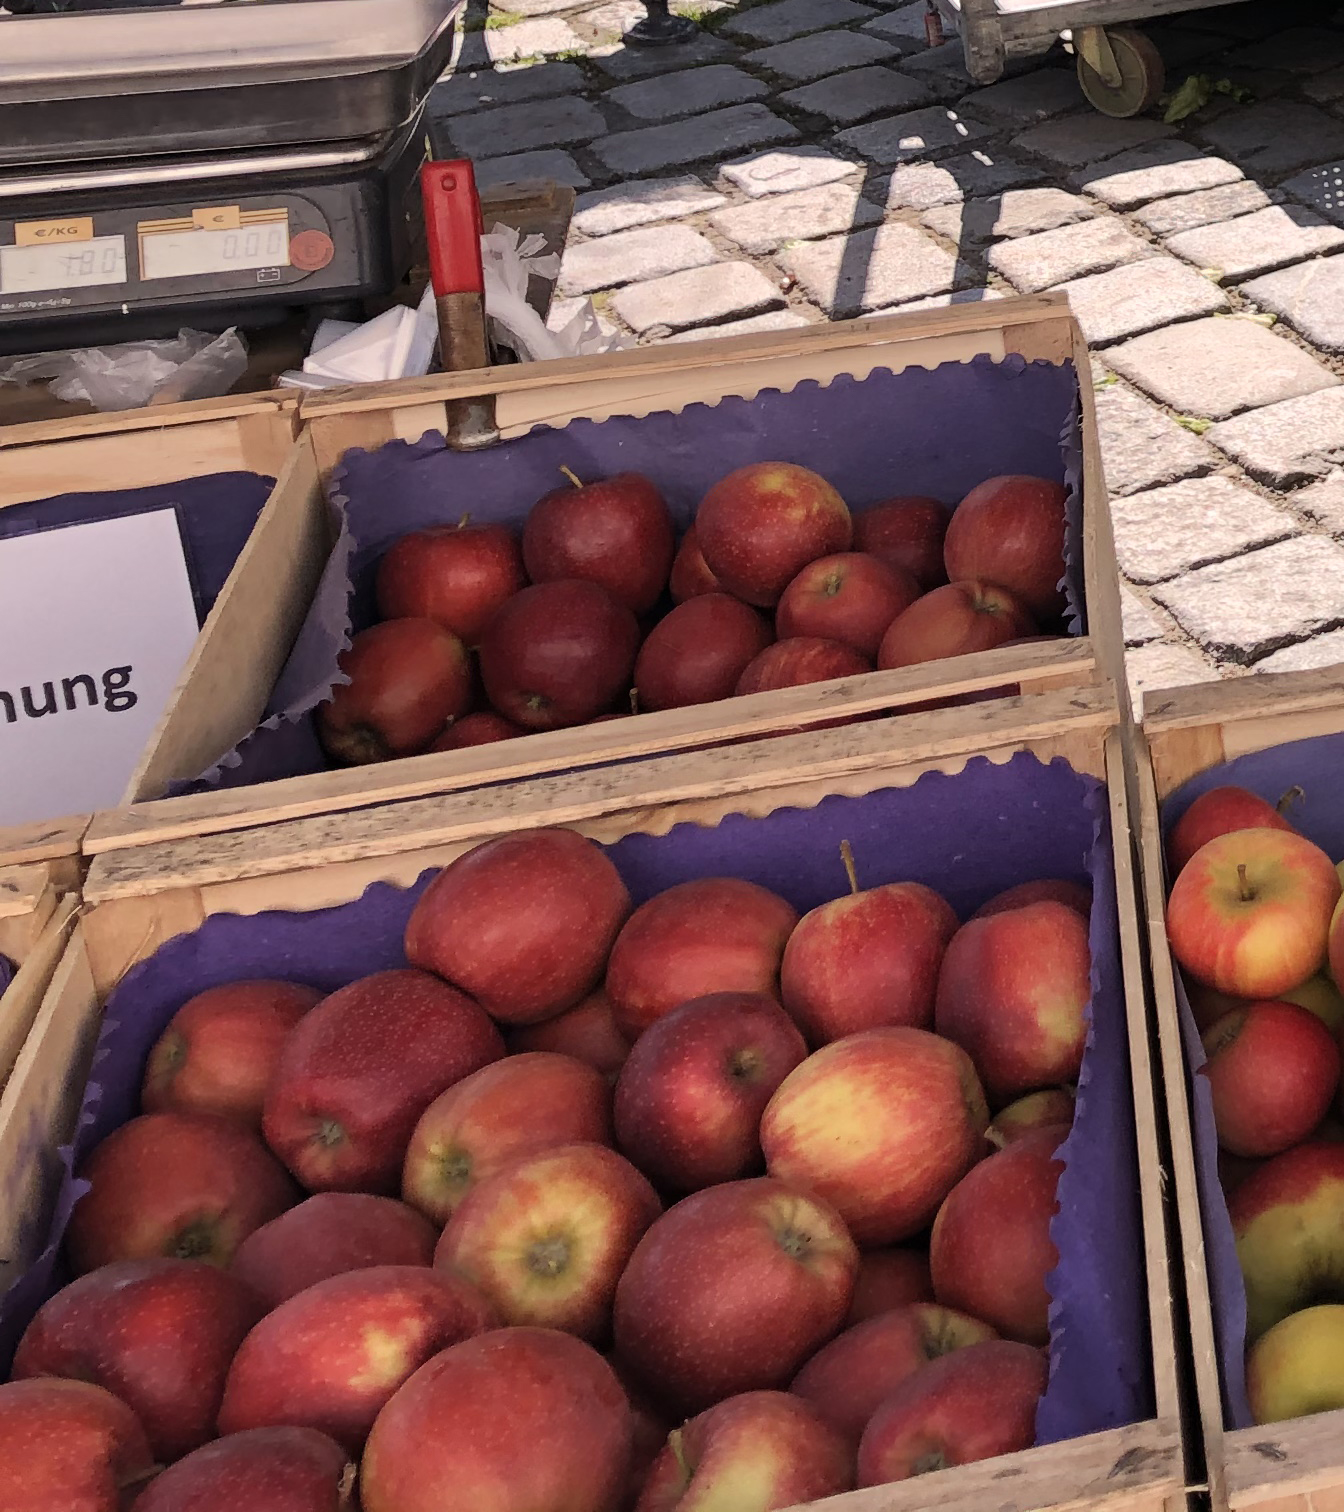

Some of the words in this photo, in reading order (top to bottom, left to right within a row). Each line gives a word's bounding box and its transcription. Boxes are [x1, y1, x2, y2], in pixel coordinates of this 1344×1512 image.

[212, 214, 225, 223] €
[34, 225, 79, 237] €/KG
[223, 230, 282, 260] 0.00
